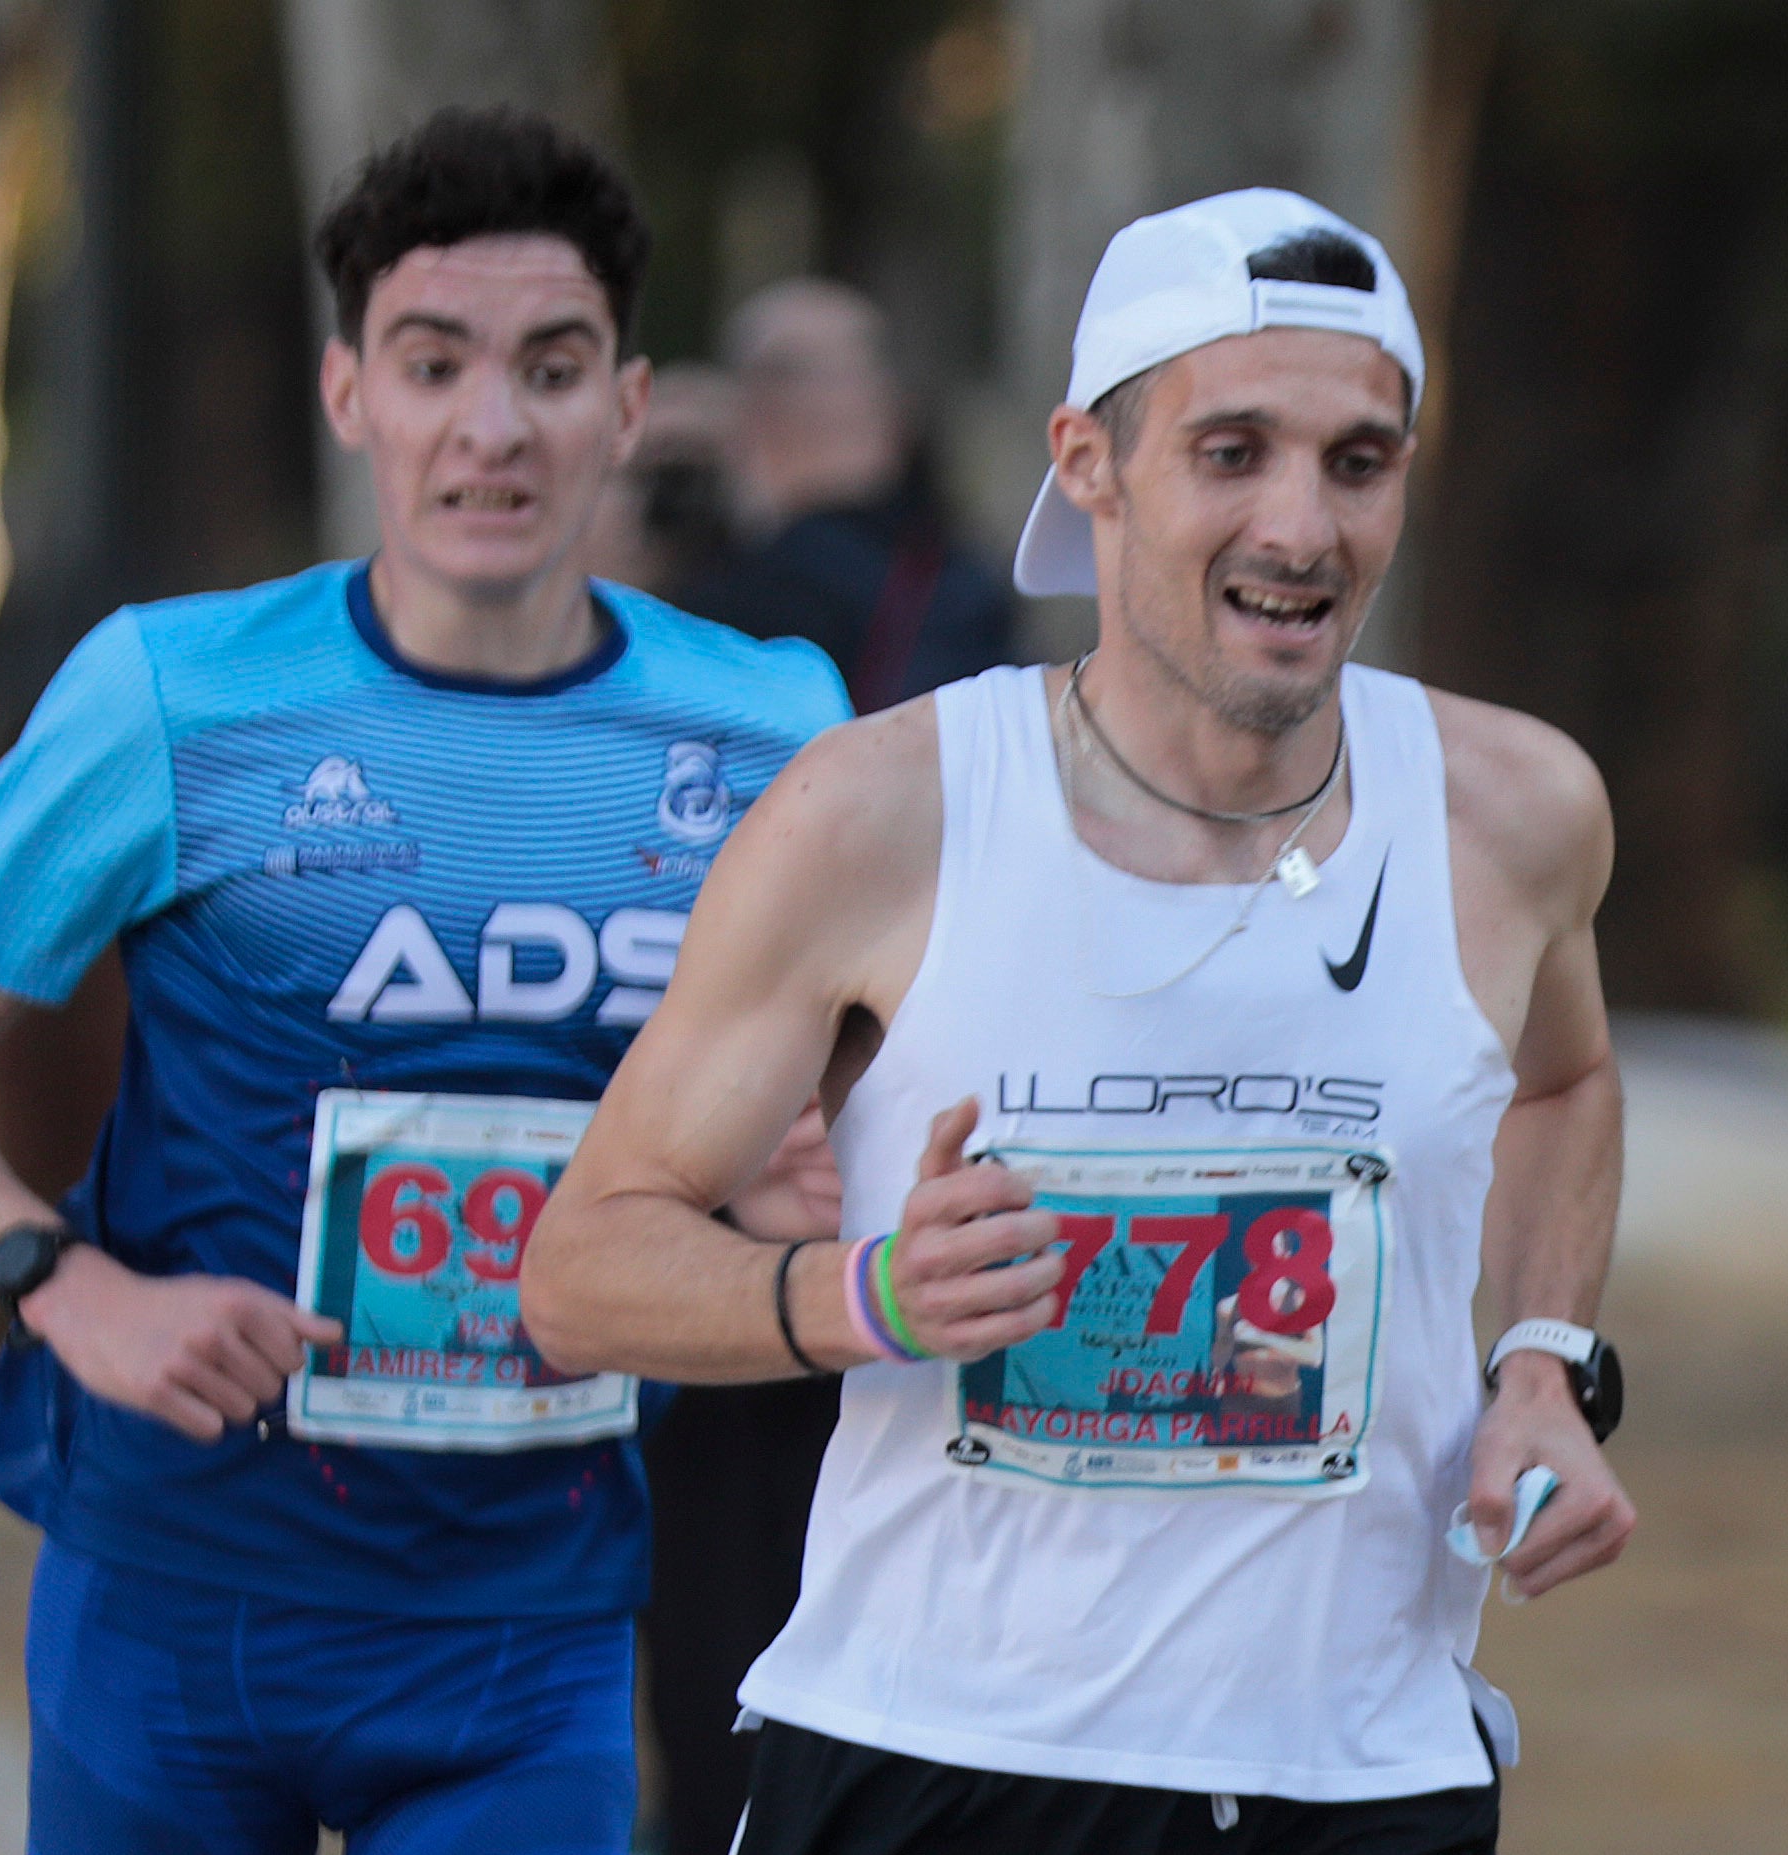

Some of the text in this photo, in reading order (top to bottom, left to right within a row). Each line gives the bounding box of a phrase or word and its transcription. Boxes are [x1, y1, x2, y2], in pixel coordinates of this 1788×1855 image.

[997, 1071, 1384, 1122] LLORO'S
[1053, 1206, 1335, 1335] 778
[1098, 1366, 1257, 1398] JOAQUIN
[965, 1399, 1352, 1443] MAYORGA PARRILLA
